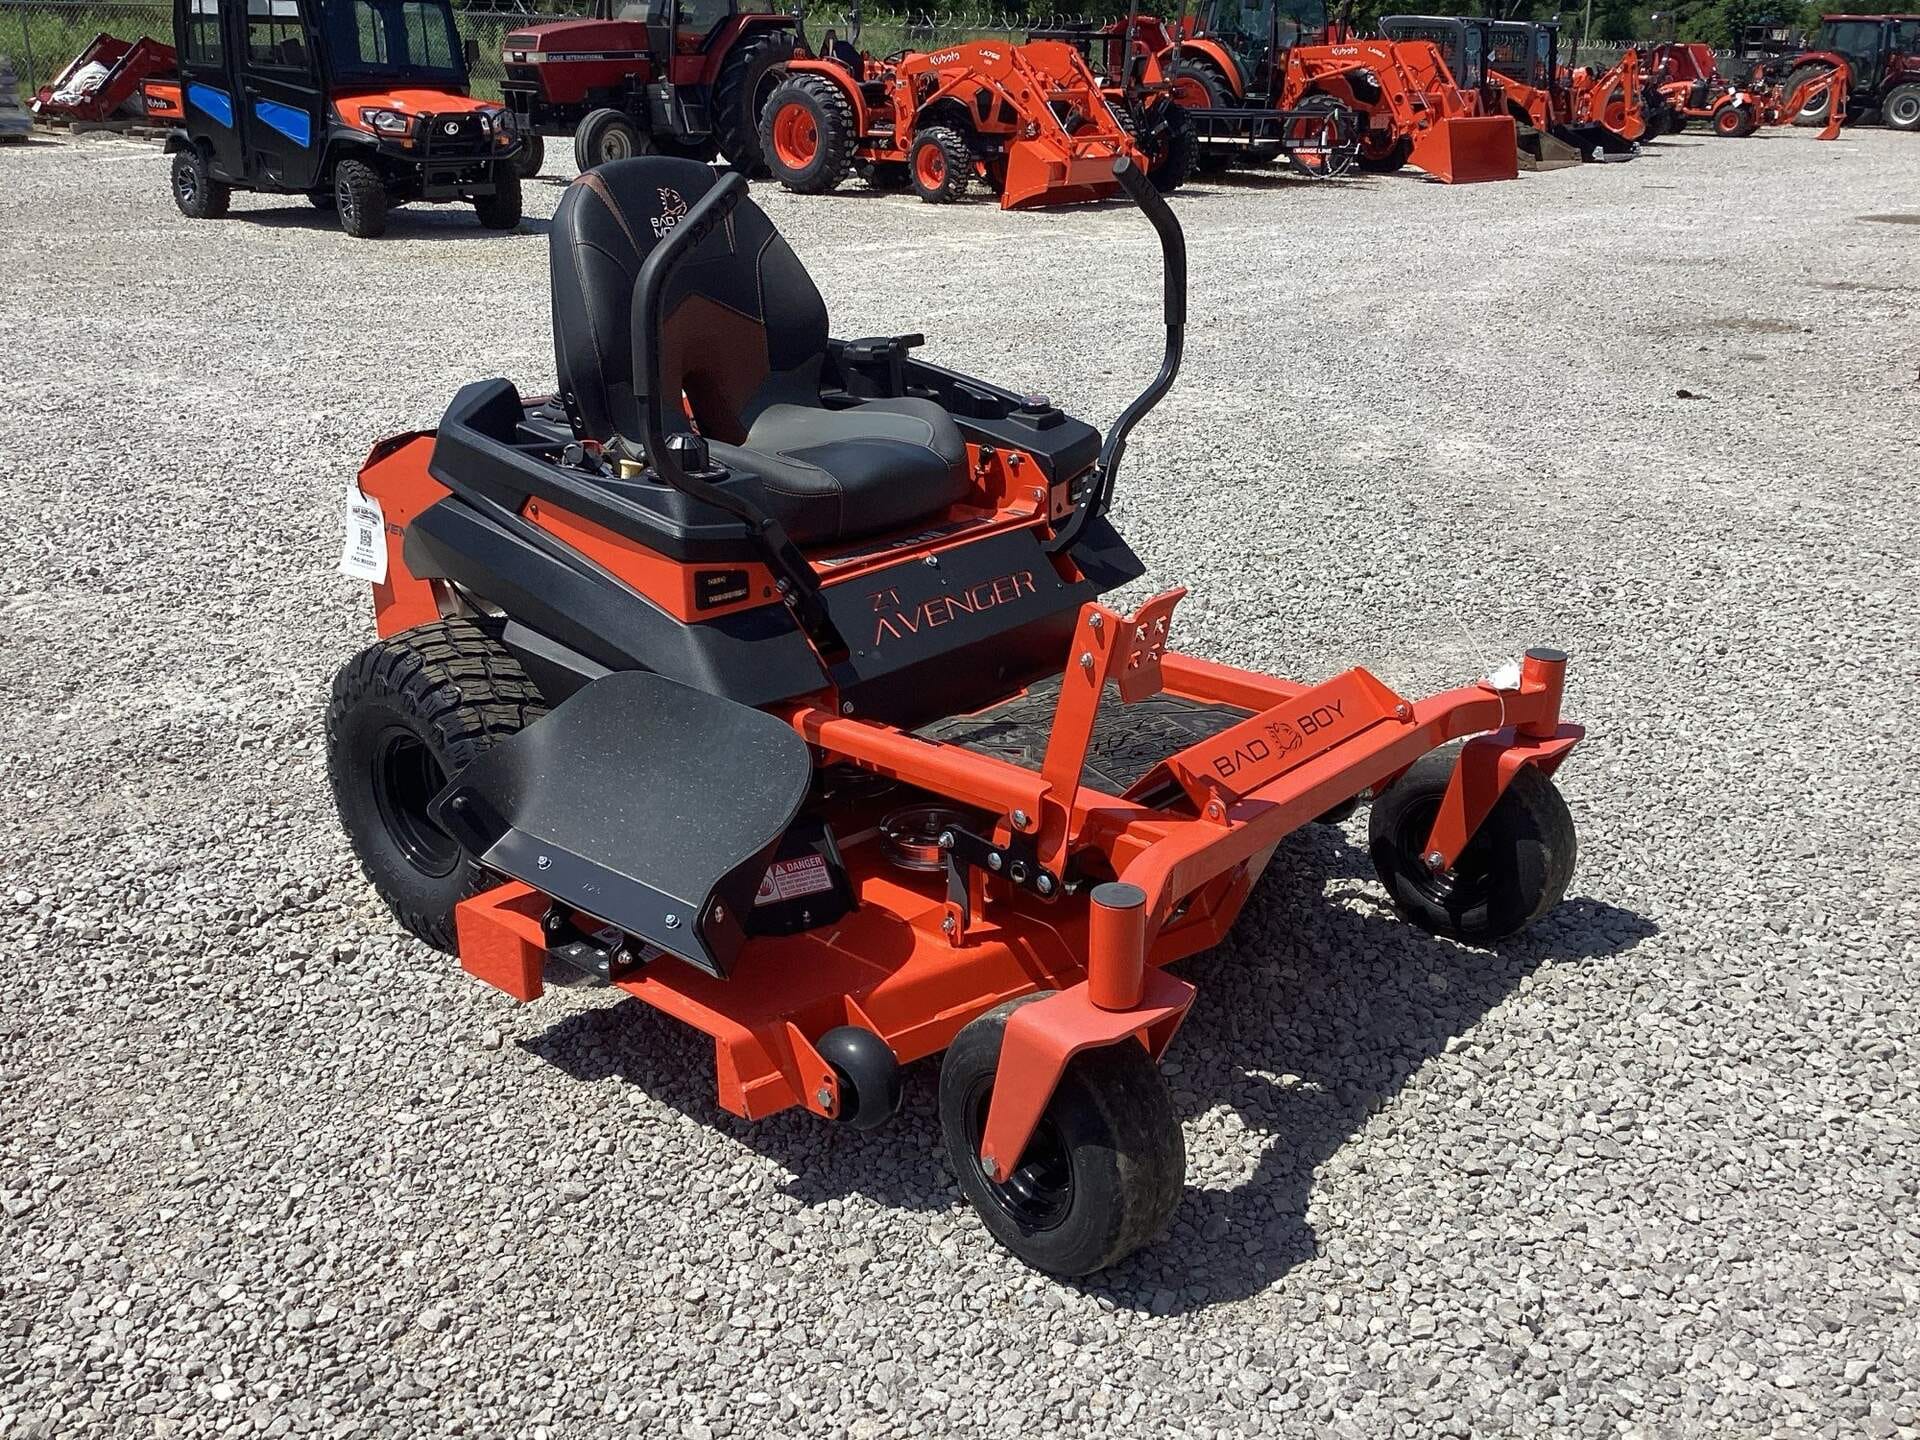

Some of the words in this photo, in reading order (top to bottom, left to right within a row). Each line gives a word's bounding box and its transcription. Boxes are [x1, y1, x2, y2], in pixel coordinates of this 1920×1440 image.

[929, 51, 960, 65] Kubota
[1332, 47, 1358, 56] Kubota
[650, 217, 675, 228] BAD
[874, 570, 1037, 646] AVENGER
[1212, 739, 1270, 778] BAD
[1297, 699, 1345, 735] BOY
[787, 857, 822, 872] DANGER
